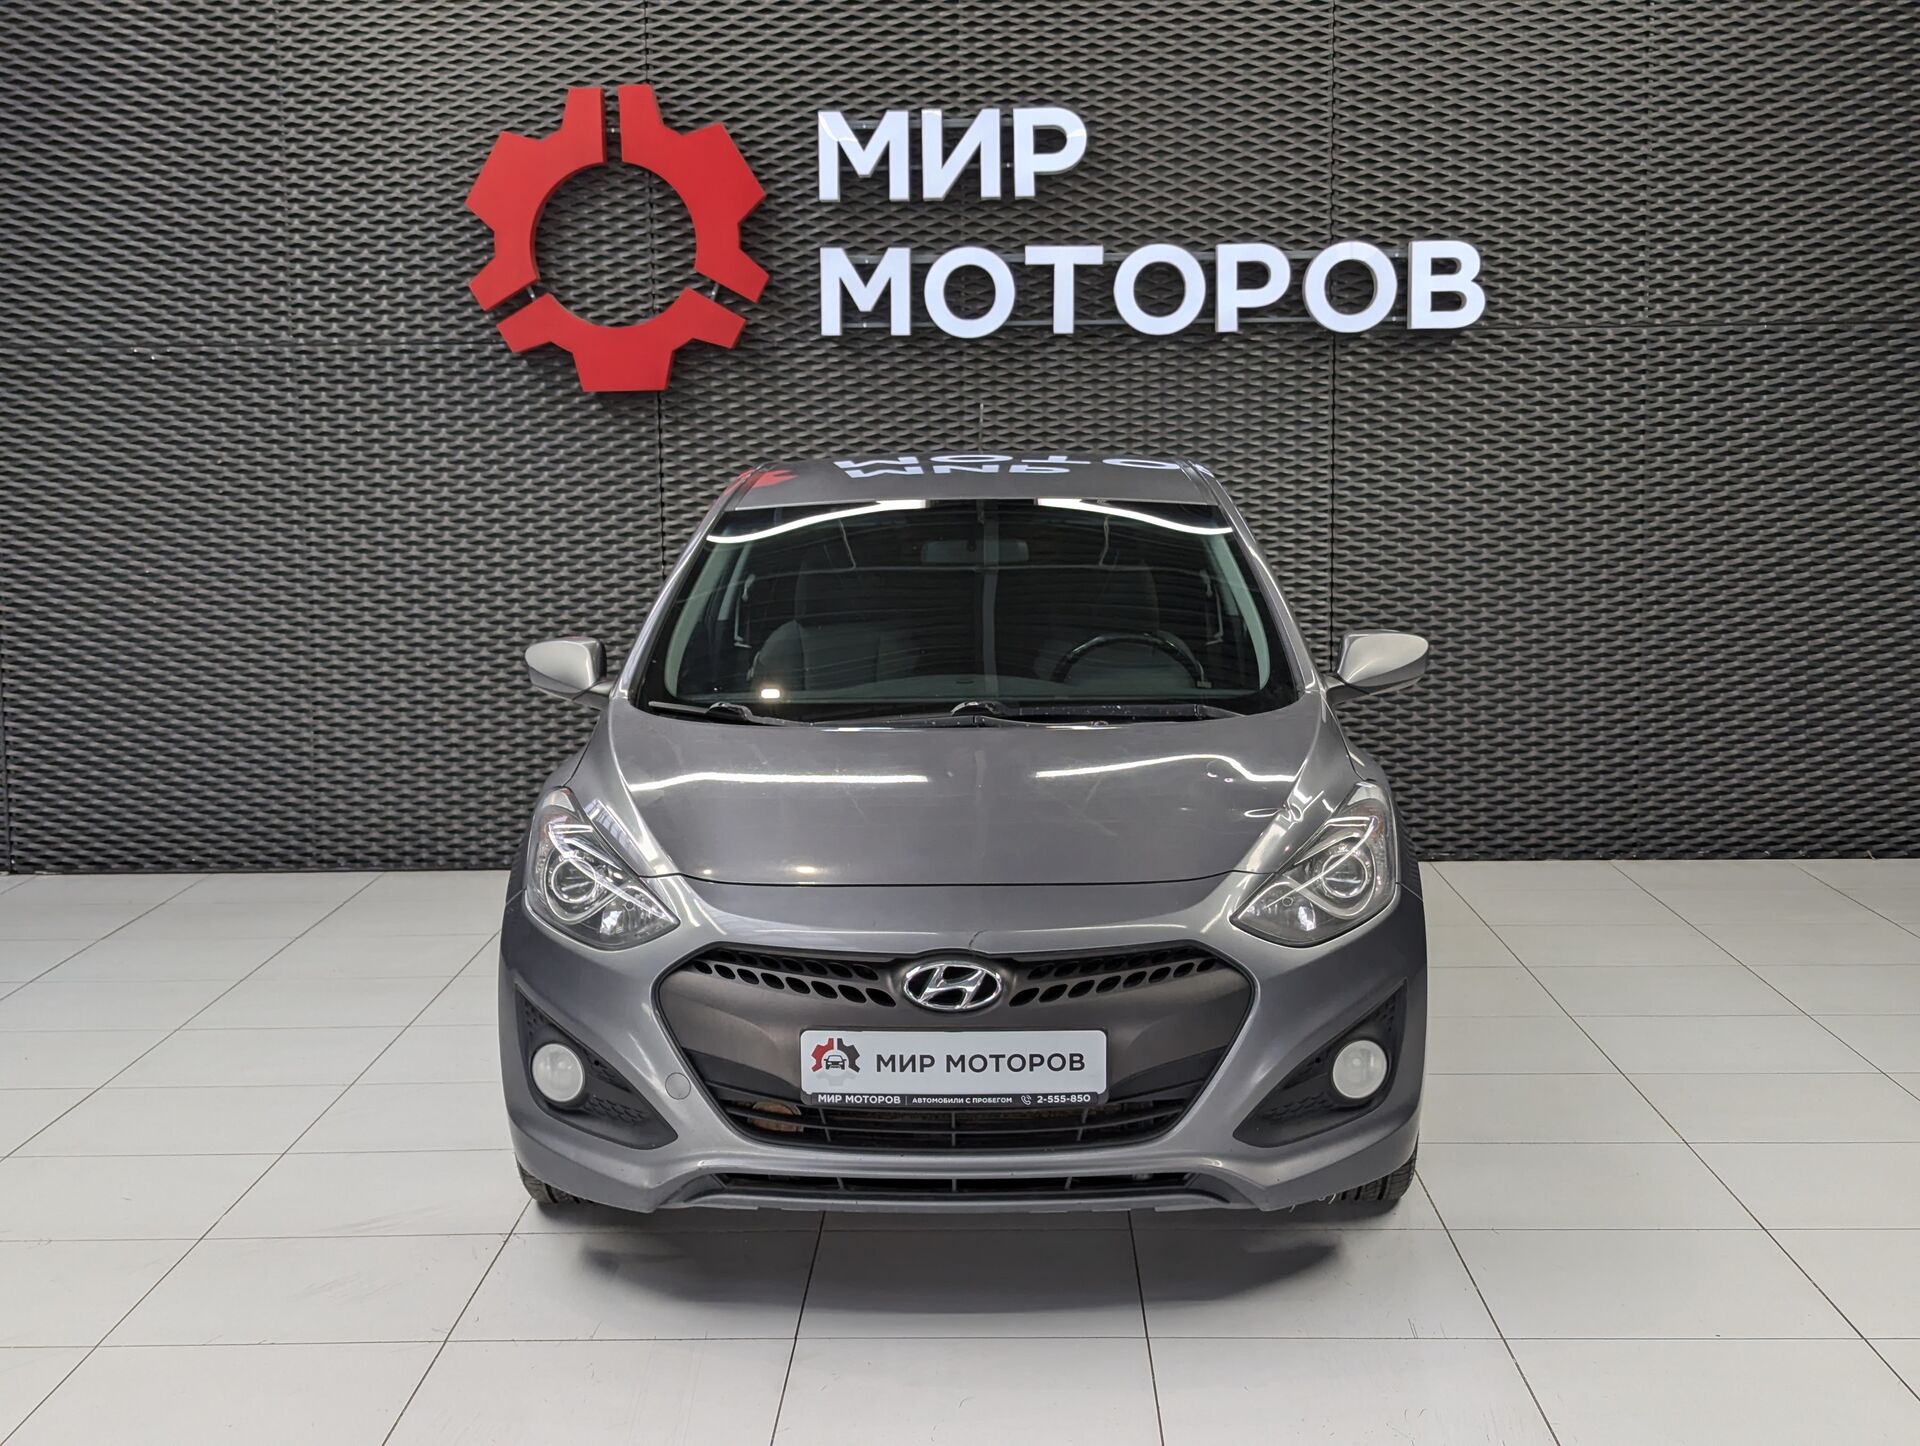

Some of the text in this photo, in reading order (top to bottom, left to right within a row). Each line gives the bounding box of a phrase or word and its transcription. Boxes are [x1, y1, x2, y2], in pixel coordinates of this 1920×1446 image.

[817, 107, 1088, 201] МИР
[820, 240, 1486, 338] МОТОРОВ
[876, 1053, 1086, 1073] МИР МОТОРОВ
[818, 1094, 901, 1104] МИР МОТОРОВ
[1037, 1094, 1091, 1104] 2-555-850
